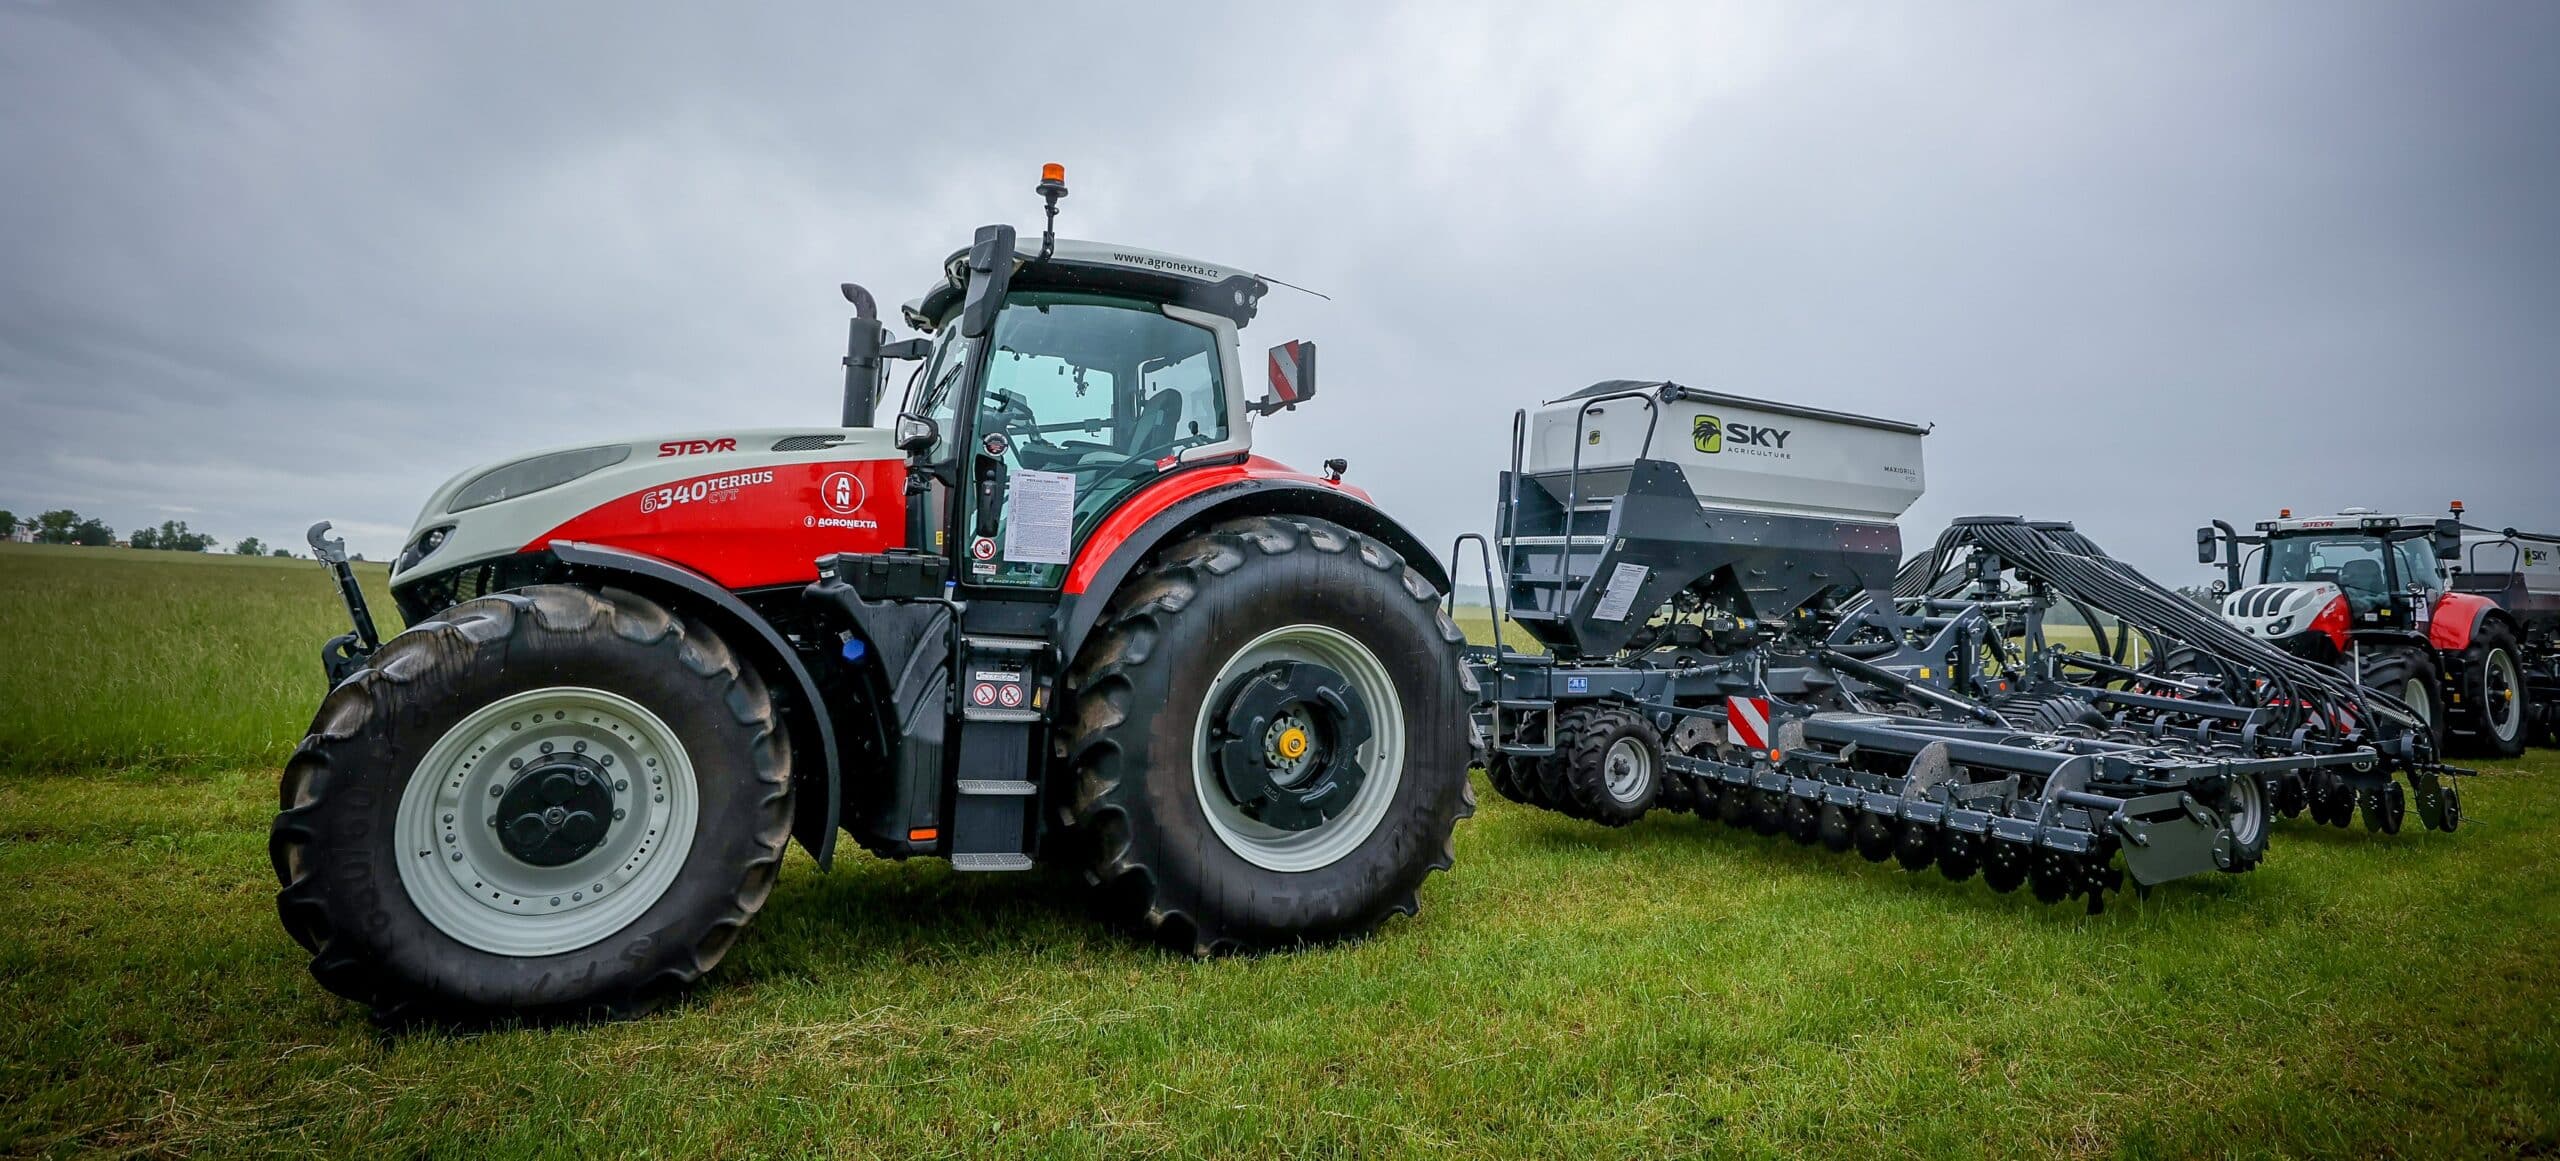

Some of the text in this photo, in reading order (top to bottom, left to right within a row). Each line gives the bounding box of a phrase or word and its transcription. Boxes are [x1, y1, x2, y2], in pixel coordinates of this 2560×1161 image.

[1113, 252, 1218, 278] www.agronexta.cz
[1726, 423, 1791, 448] SKY
[657, 438, 737, 457] STEYR
[1727, 447, 1791, 459] AGRICULTURE
[640, 471, 773, 513] 6340 TERRUS
[709, 488, 739, 503] CVT
[818, 518, 877, 528] AGRONEXTA
[2532, 550, 2547, 560] SKY
